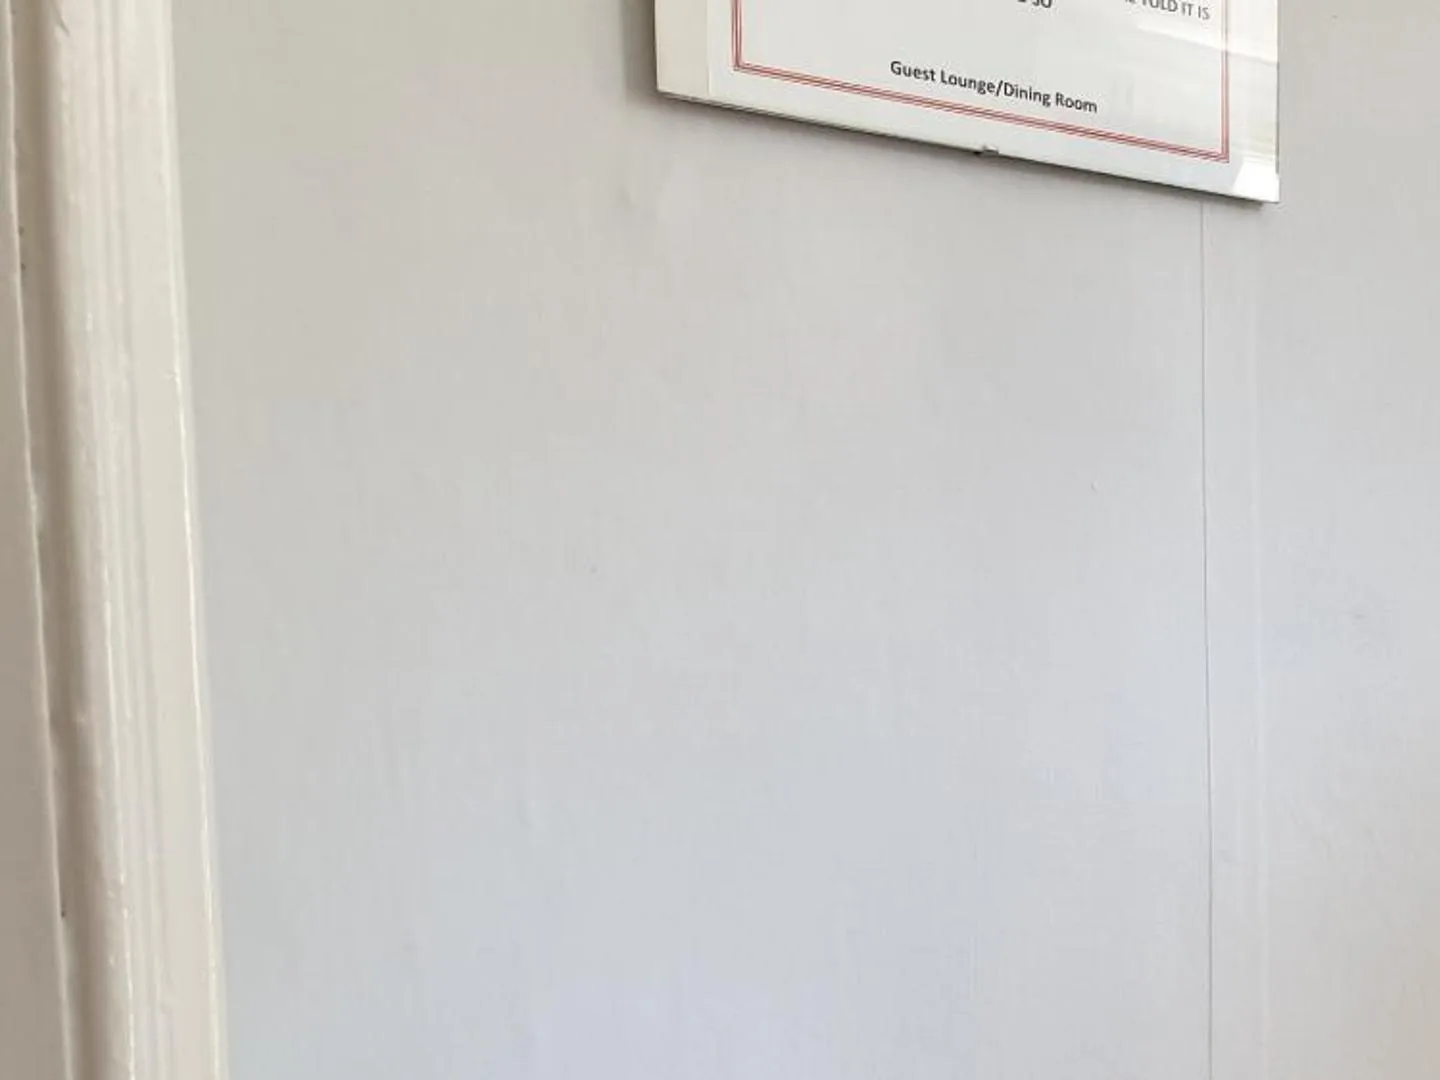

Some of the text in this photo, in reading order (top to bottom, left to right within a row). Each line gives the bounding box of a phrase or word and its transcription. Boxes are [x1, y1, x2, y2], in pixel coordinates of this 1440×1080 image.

[890, 60, 1098, 113] Guest Lounge/Dining Room
